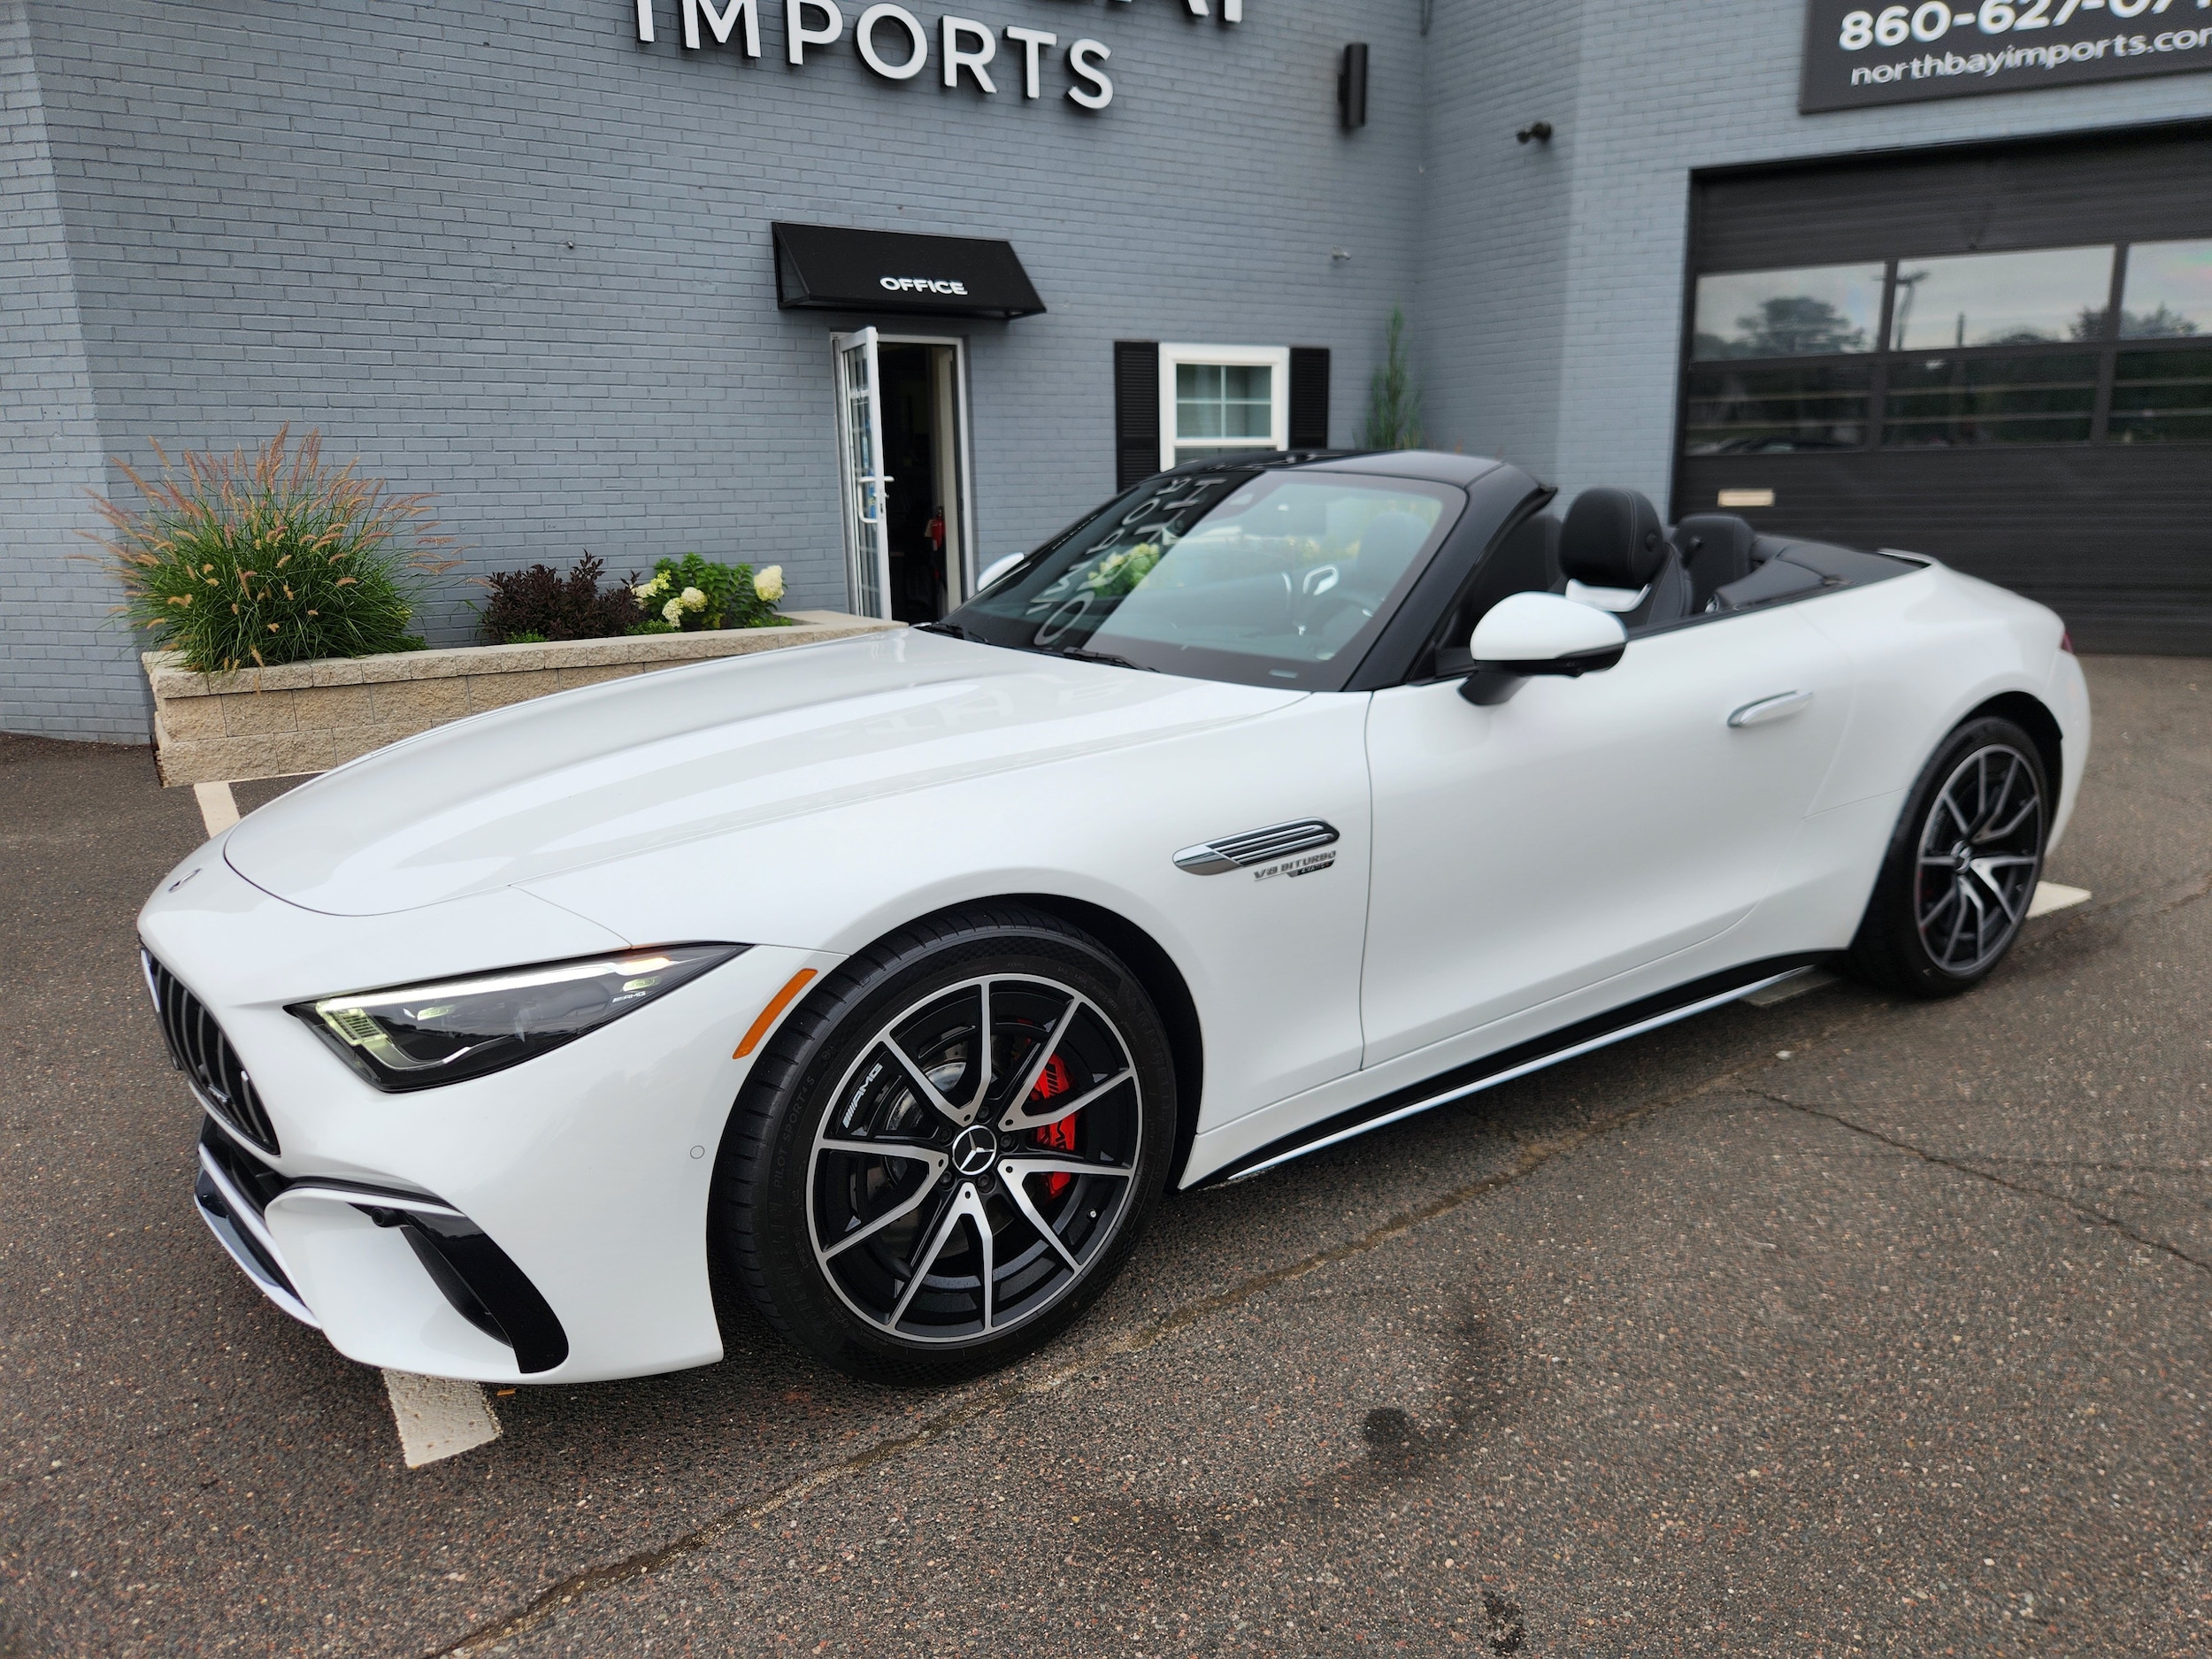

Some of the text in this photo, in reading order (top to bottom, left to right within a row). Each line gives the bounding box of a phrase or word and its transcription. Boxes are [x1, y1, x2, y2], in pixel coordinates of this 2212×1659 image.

[1839, 0, 2212, 50] 860-627-
[635, 0, 1114, 110] IMPORTS
[879, 277, 968, 295] OFFICE
